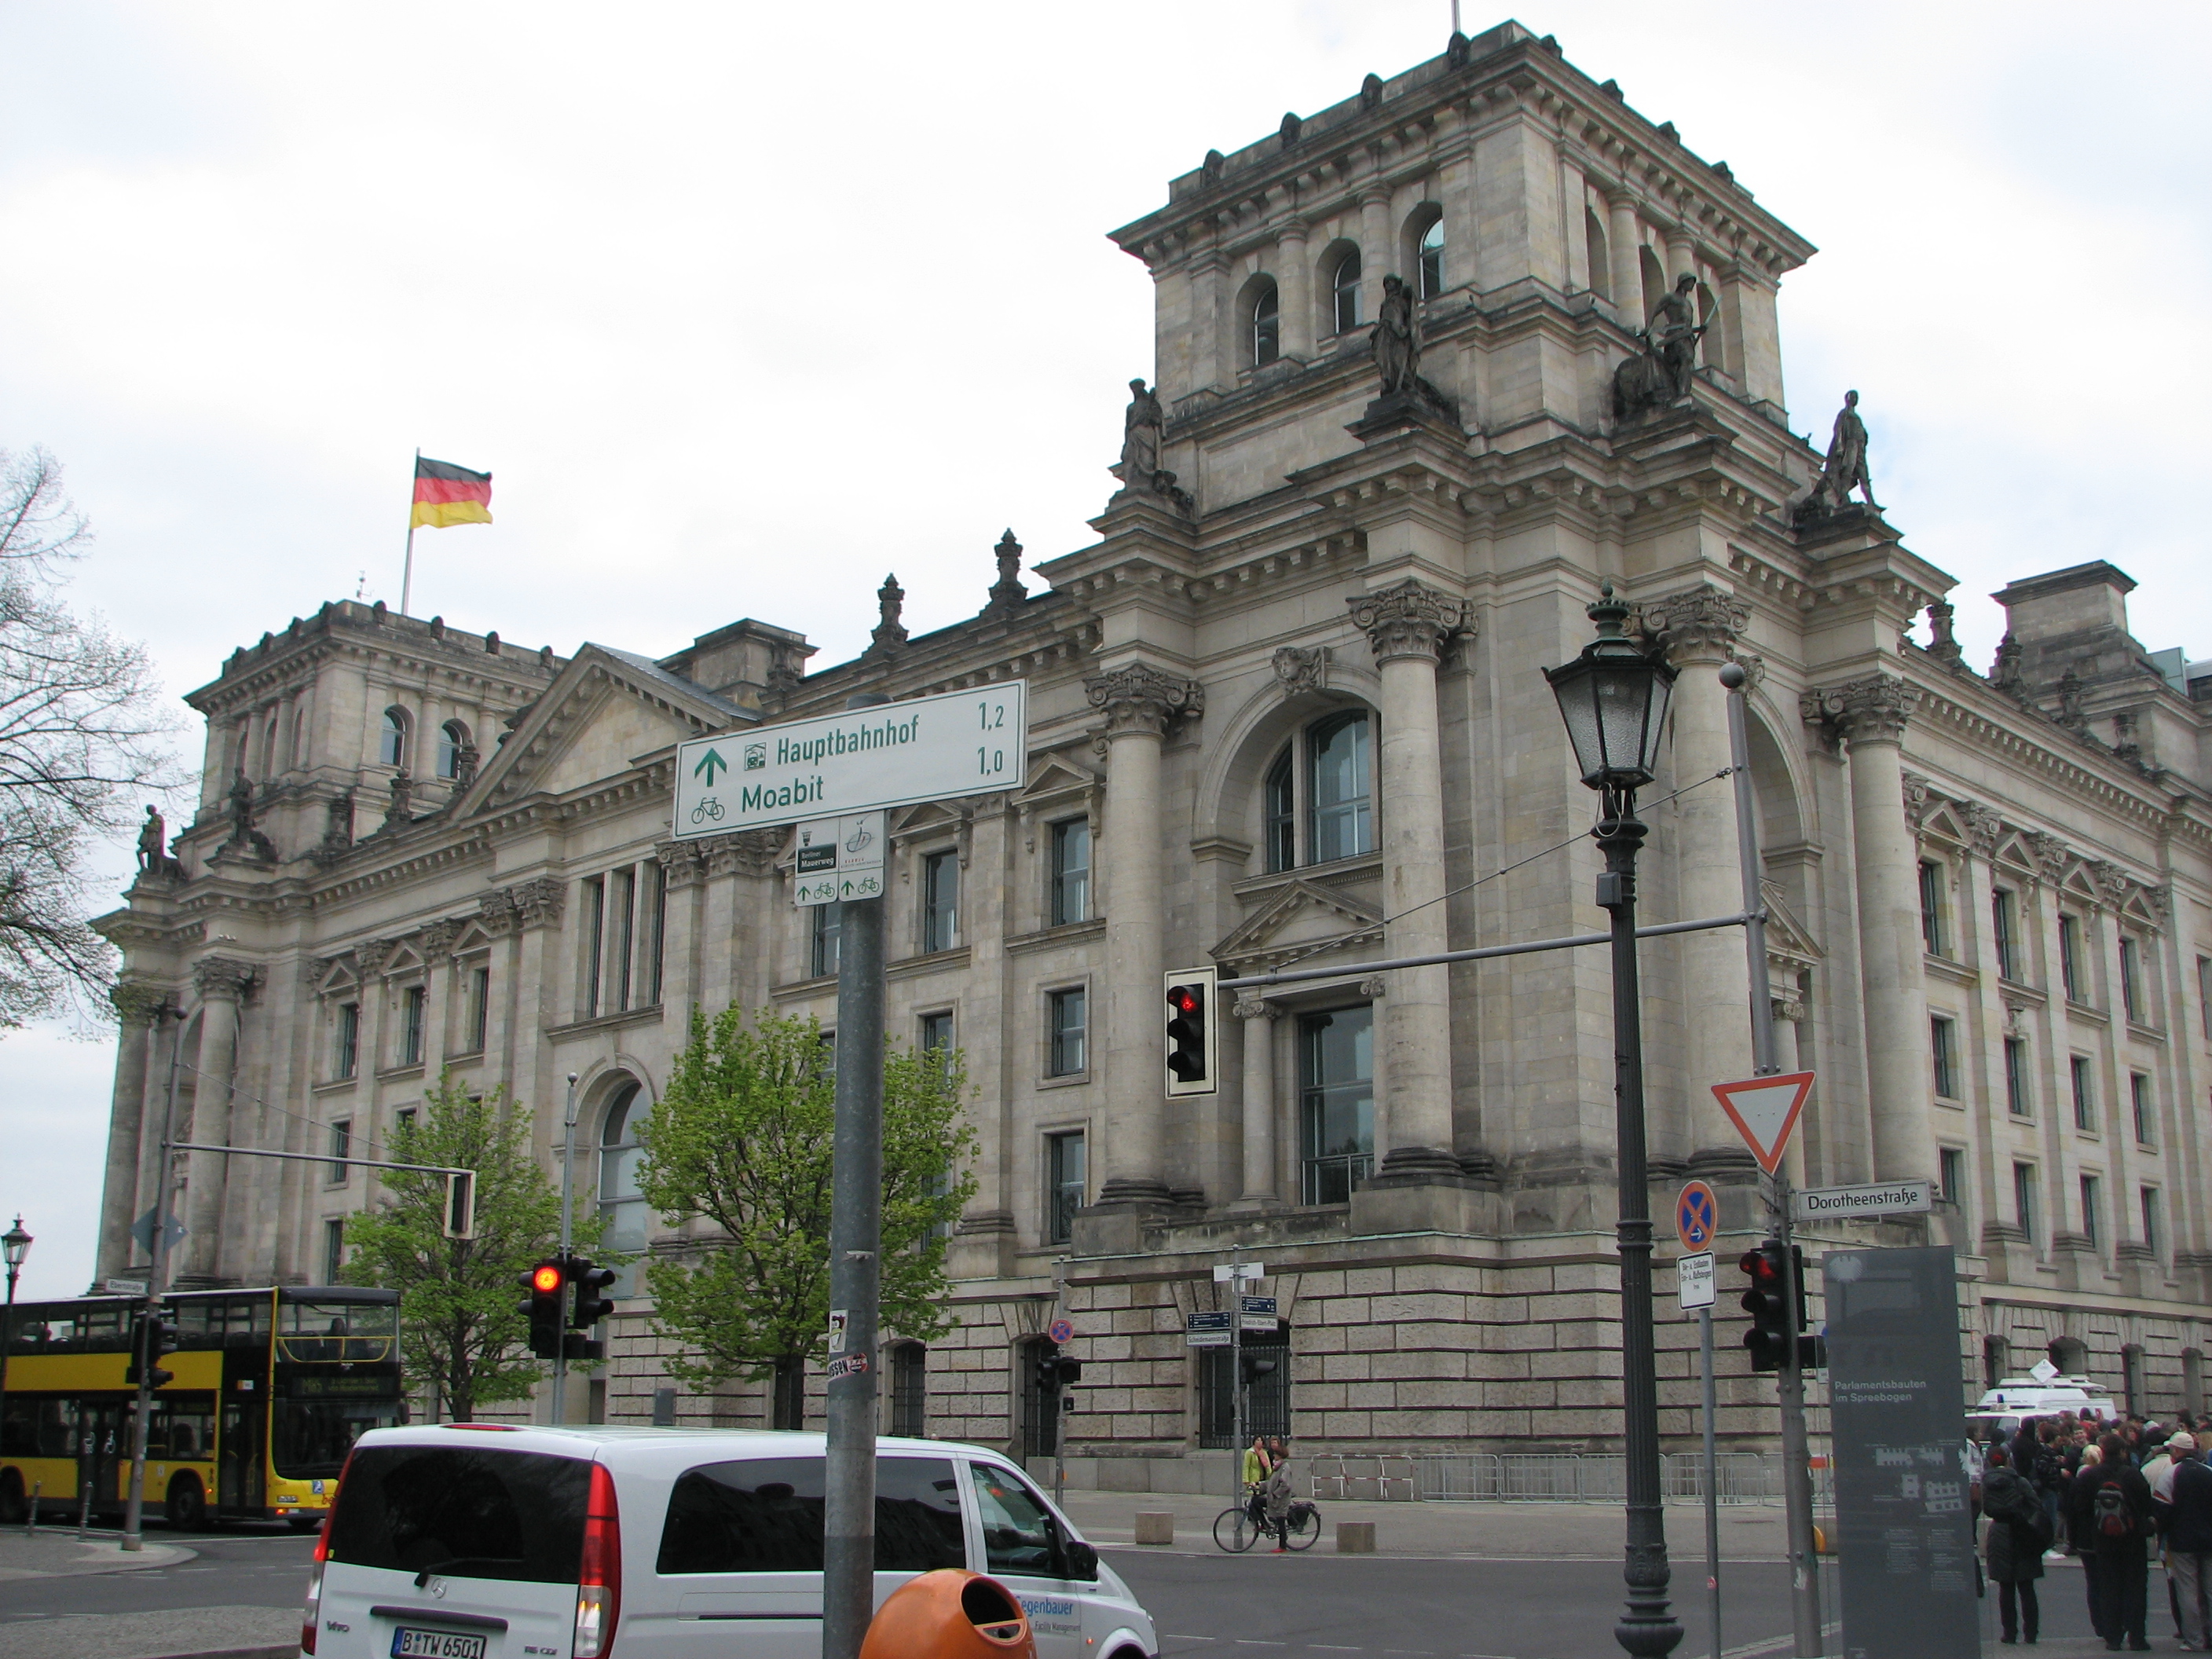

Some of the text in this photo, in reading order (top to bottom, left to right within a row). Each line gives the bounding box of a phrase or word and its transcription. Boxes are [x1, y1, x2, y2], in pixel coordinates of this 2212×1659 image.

[777, 701, 1004, 766] Hauptbahnhof 1,2
[741, 746, 1004, 812] Moabit 1,0
[800, 857, 834, 868] Mauerweg
[1808, 1187, 1918, 1210] Dorotheenstraße
[1834, 1379, 1927, 1390] Parlamentsbauten
[1835, 1392, 1913, 1404] im Spreebogen
[1035, 1621, 1081, 1634] Facility Management
[401, 1632, 480, 1658] B TW 6501
